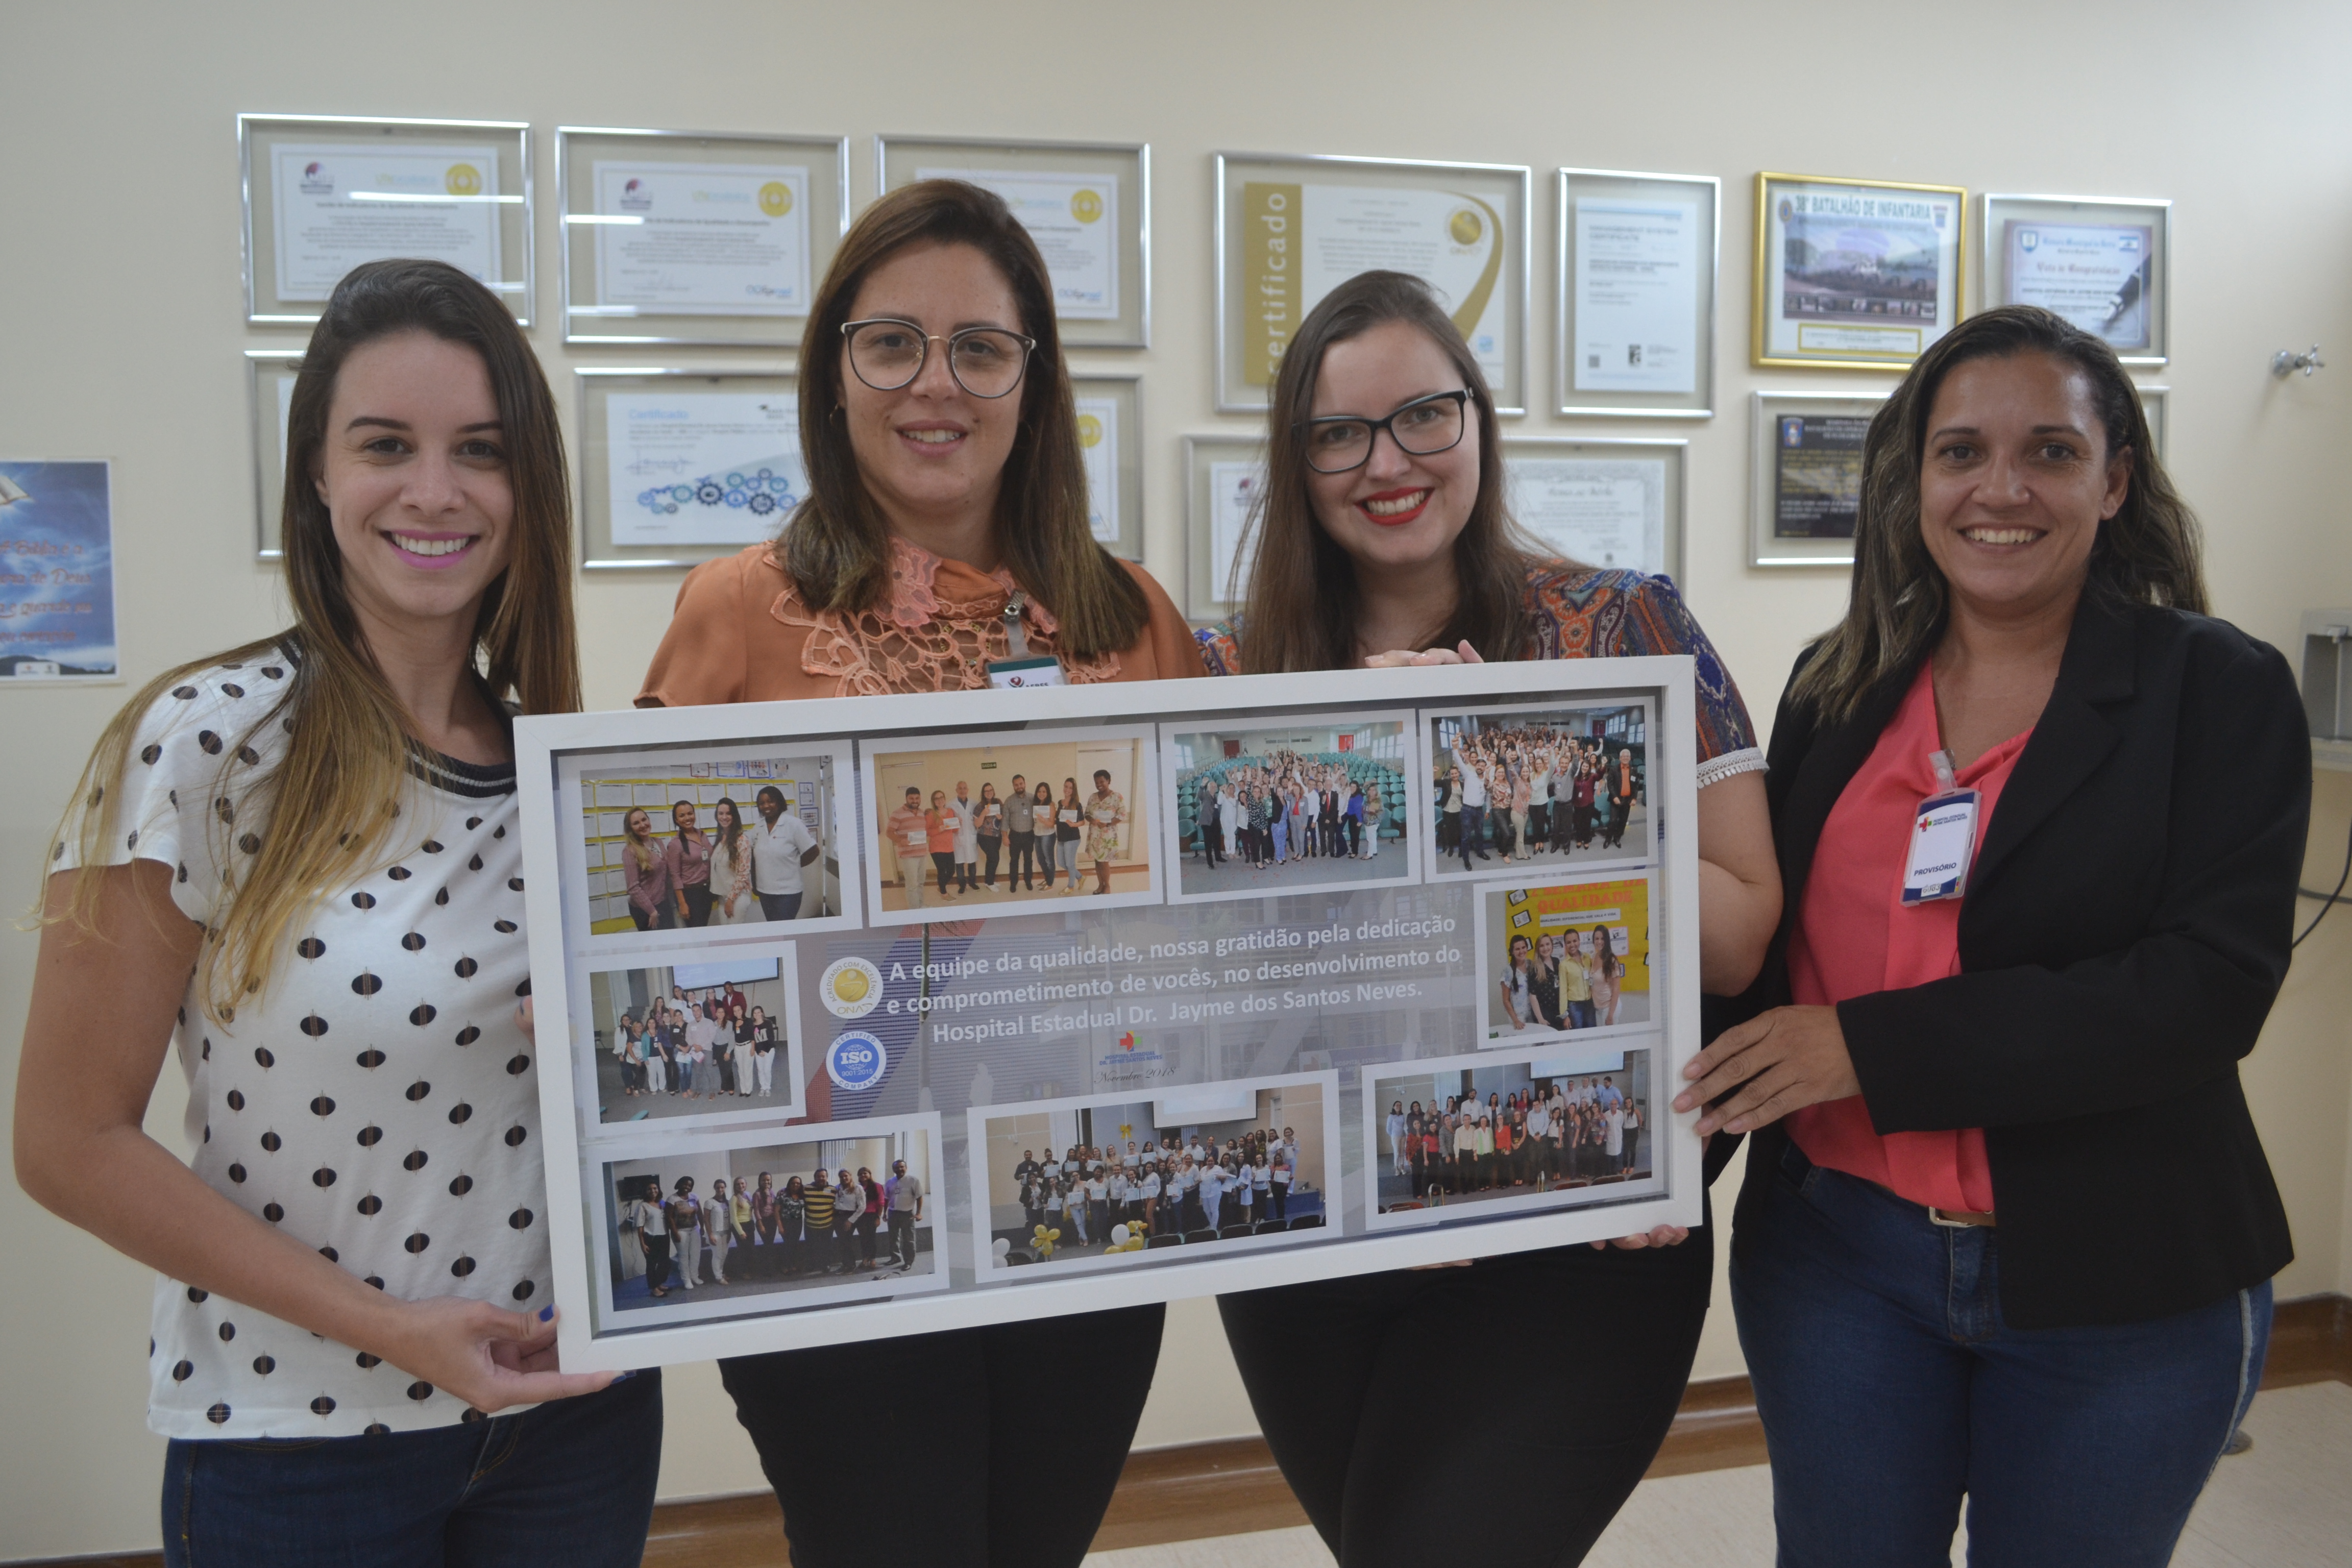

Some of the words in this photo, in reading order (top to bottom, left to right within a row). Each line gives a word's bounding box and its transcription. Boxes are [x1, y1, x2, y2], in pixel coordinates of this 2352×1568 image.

[1863, 198, 1874, 217] DE
[1877, 201, 1930, 219] INFANTARIA
[1914, 862, 1957, 876] PROVISÓRIO
[1537, 890, 1633, 914] QUALIDADE
[890, 962, 906, 981] A
[912, 957, 989, 982] equipe
[996, 952, 1022, 972] da
[1029, 943, 1143, 972] qualidade,
[1150, 940, 1209, 959] nossa
[1215, 928, 1302, 957] gratidão
[1308, 924, 1350, 949] pela
[1356, 915, 1455, 940] dedicação
[826, 964, 842, 1002] ACREDITADO
[860, 964, 877, 999] EXCELÊNCIA
[887, 999, 900, 1014] e
[906, 978, 1114, 1013] comprometimento
[1120, 973, 1146, 993] de
[1152, 967, 1217, 988] vocês,
[1224, 968, 1250, 984] no
[1256, 950, 1430, 980] desenvolvimento
[1435, 945, 1460, 964] do
[933, 1016, 1024, 1043] Hospital
[1031, 1007, 1121, 1033] Estadual
[1129, 1006, 1157, 1024] Dr.
[1169, 1000, 1235, 1022] Jayme
[1241, 994, 1277, 1013] dos
[1283, 989, 1351, 1009] Santos
[1357, 983, 1423, 1002] Neves.
[836, 1032, 876, 1045] CERTIFIED
[840, 1050, 872, 1065] ISO
[841, 1068, 873, 1076] 9001:2015
[1094, 1070, 1141, 1084] Novembro
[1145, 1067, 1177, 1079] 2018
[839, 1075, 878, 1089] COMPANY
